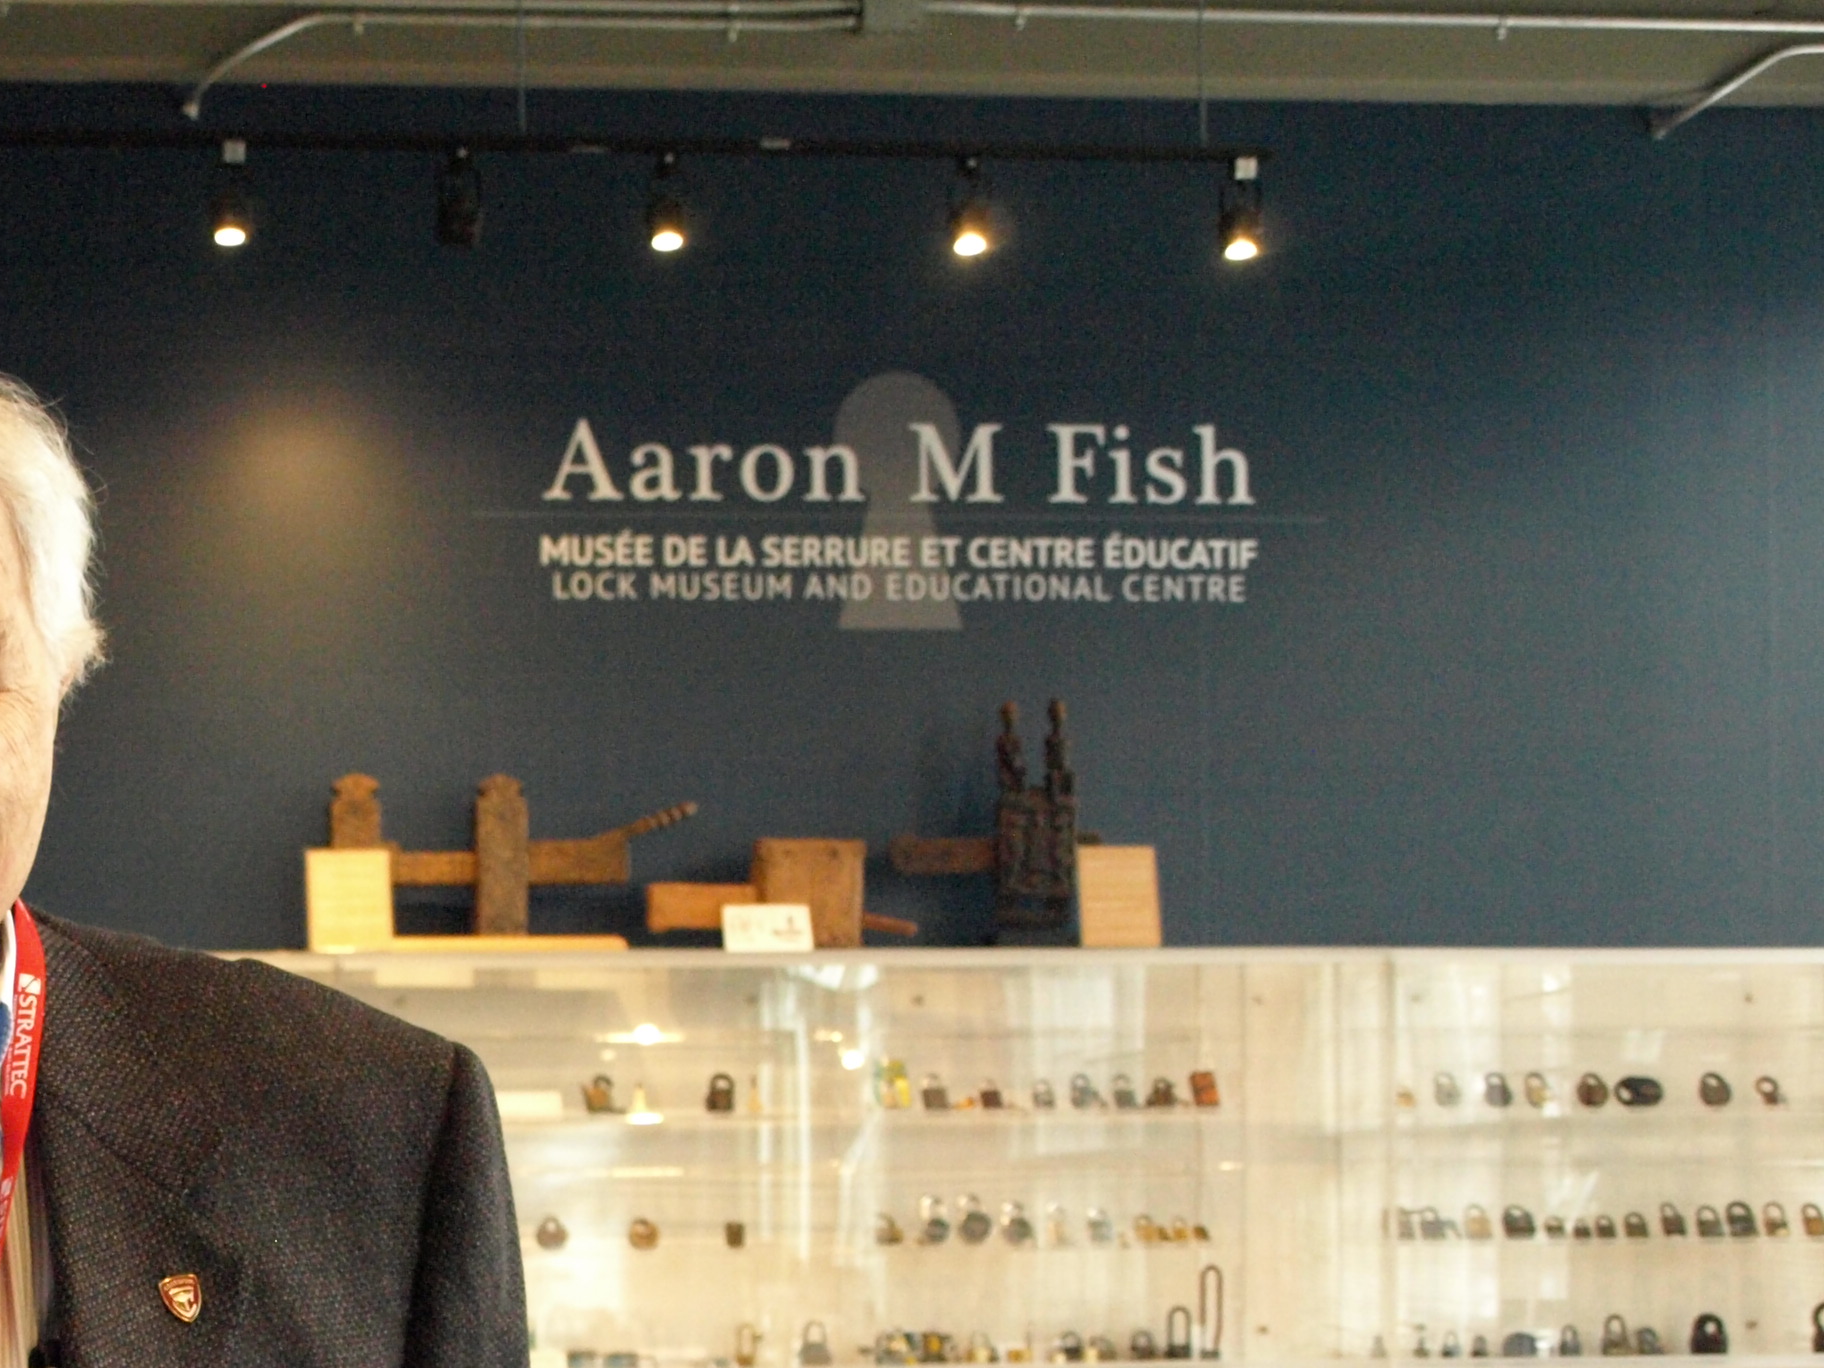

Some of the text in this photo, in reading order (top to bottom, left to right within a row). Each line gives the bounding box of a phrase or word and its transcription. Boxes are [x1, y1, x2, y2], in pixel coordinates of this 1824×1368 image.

[542, 417, 1255, 506] Aaron M Fish
[539, 529, 1258, 570] MUSÉE DE LA SERRURE ET CENTRE ÉDUCATIF
[552, 572, 1246, 602] LOCK MUSEUM AND EDUCATIONAL CENTRE
[9, 993, 37, 1100] STRATTEC
